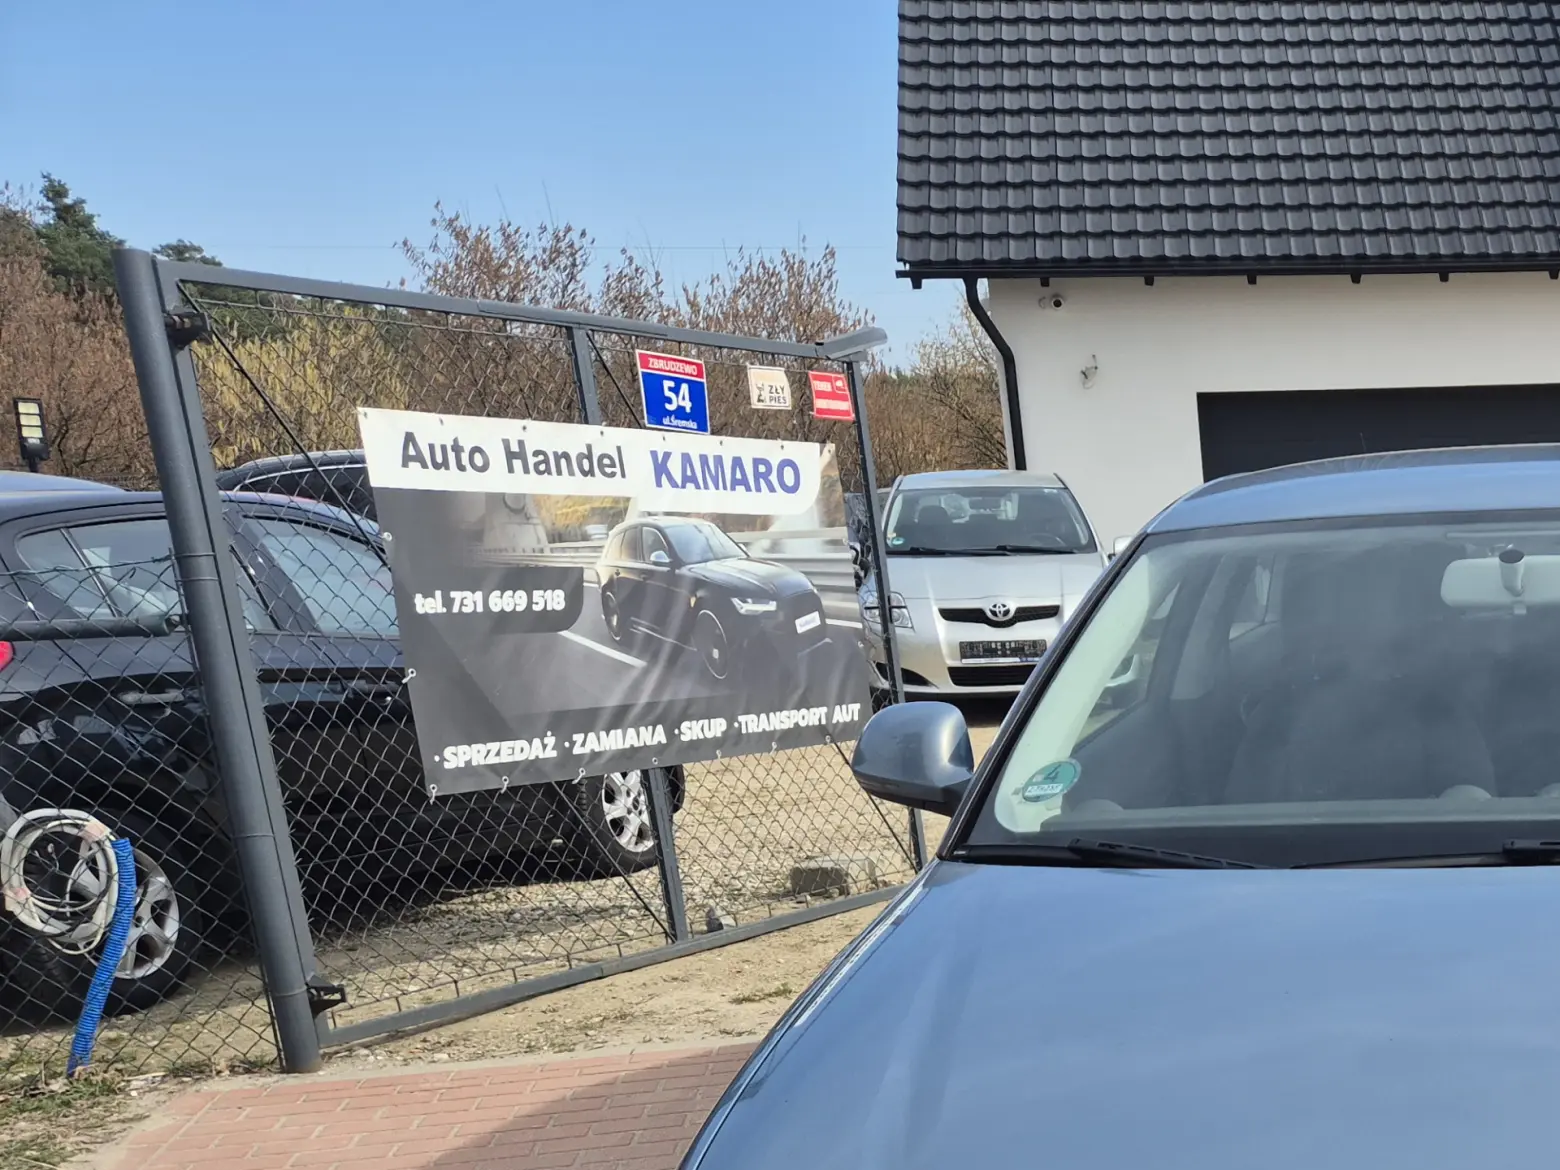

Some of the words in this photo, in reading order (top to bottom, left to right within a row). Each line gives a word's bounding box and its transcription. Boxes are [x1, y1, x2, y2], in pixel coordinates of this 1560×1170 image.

[648, 358, 698, 376] ZBRUDZEWO
[662, 379, 692, 413] 54
[768, 384, 785, 395] ZŁY
[769, 395, 787, 404] PIES
[401, 431, 490, 473] Auto
[501, 438, 626, 479] Handel
[650, 450, 801, 494] KAMARO
[414, 590, 447, 614] tel.
[450, 591, 484, 613] 731
[488, 590, 528, 613] 669
[532, 589, 566, 612] 518
[443, 730, 558, 769] SPRZEDAŻ
[572, 724, 667, 755] ZAMIANA
[680, 718, 727, 742] SKUP
[738, 706, 828, 734] TRANSPORT
[832, 703, 861, 724] AUT
